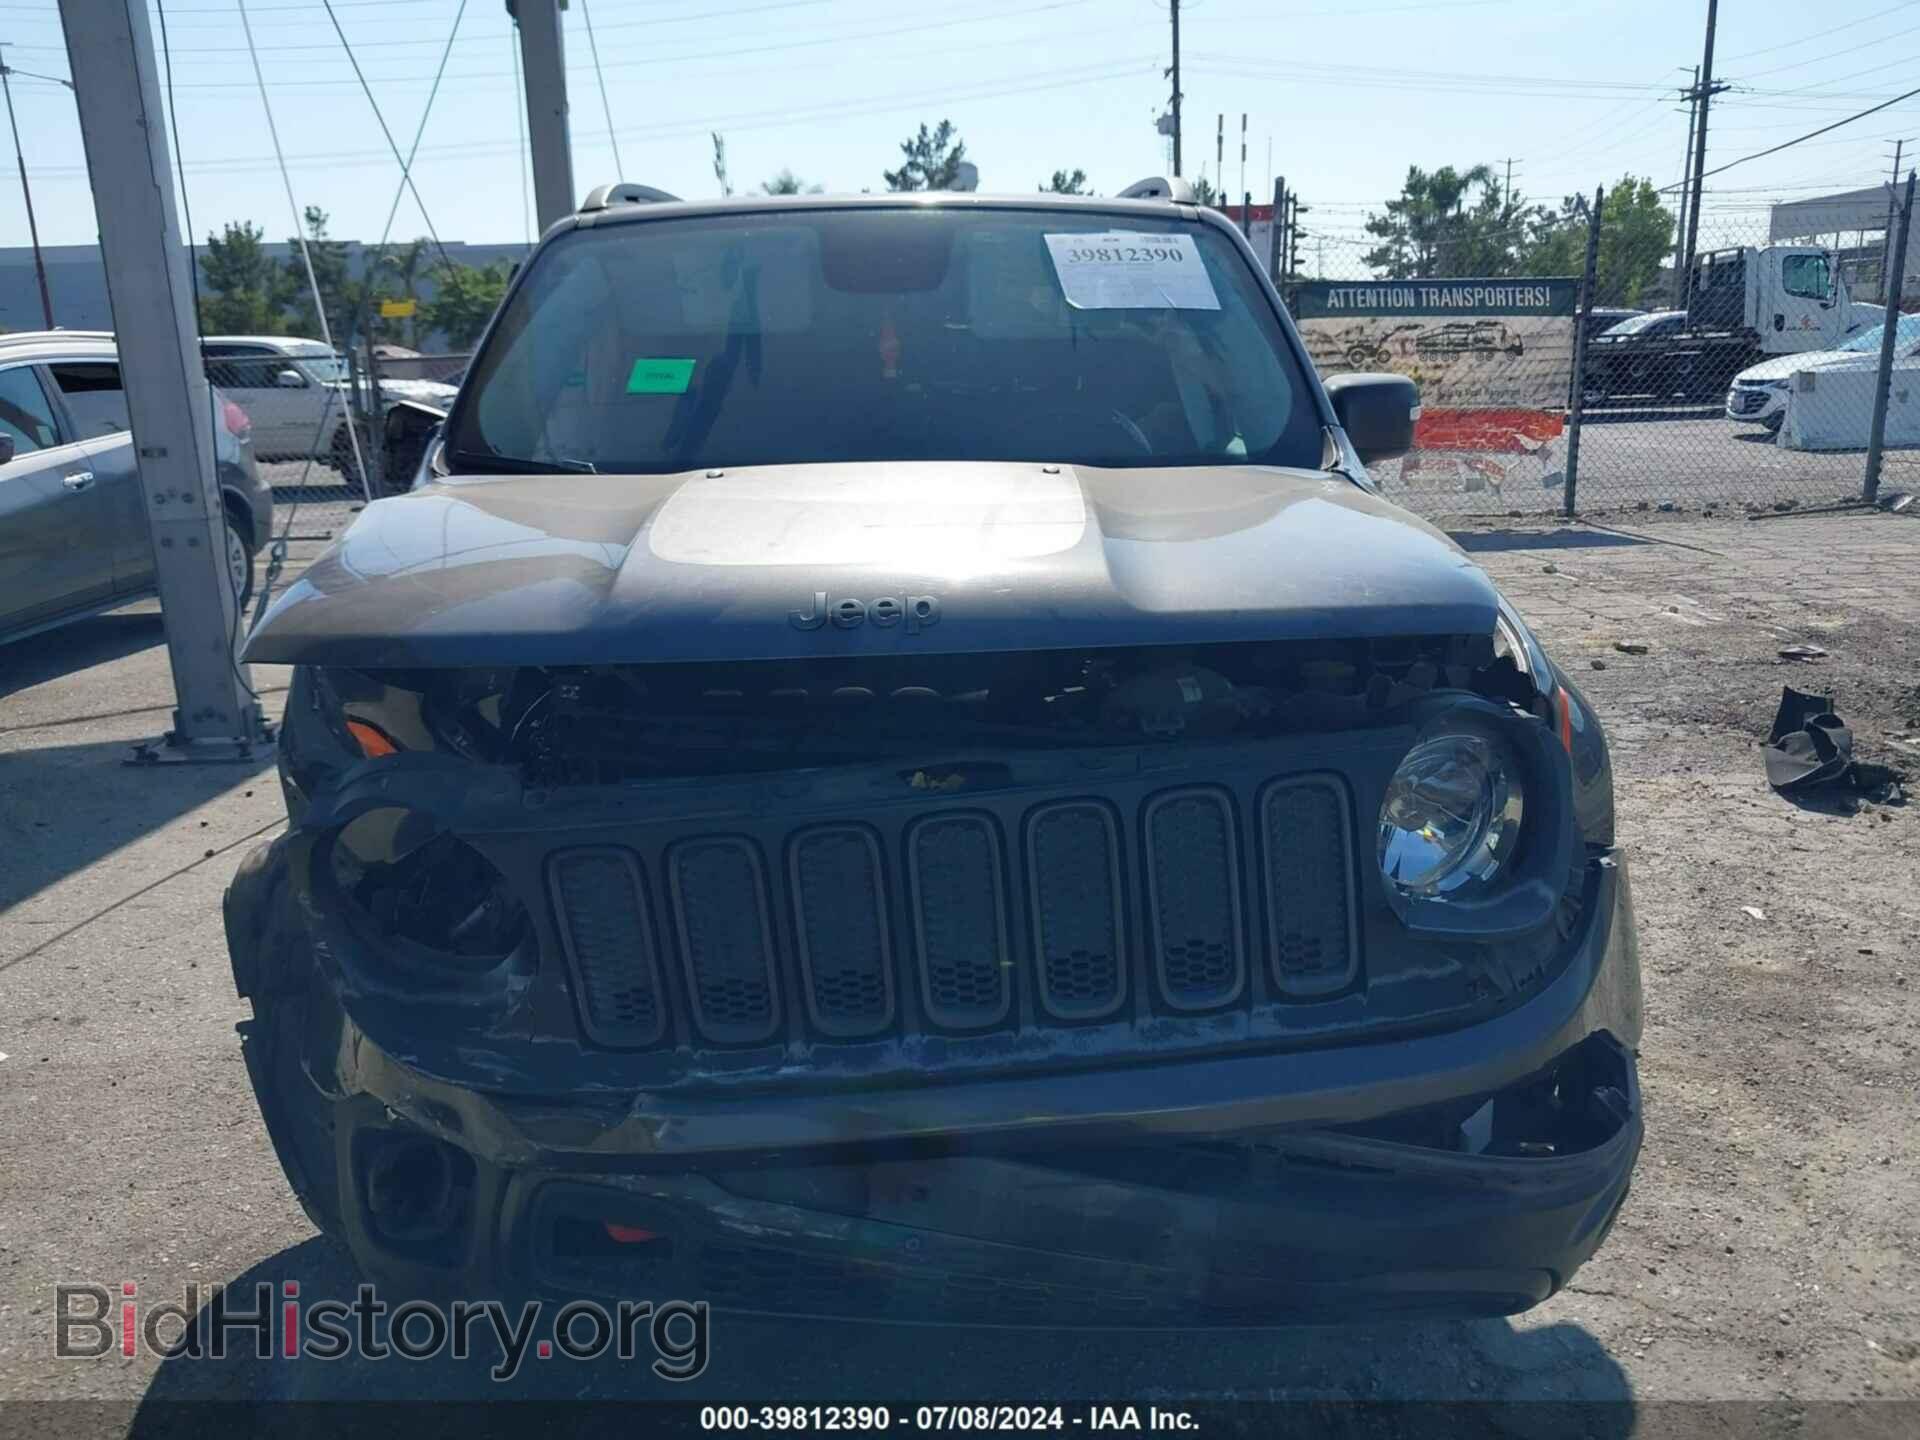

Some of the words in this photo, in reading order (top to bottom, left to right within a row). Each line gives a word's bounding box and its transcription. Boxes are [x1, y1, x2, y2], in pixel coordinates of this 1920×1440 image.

[1068, 248, 1183, 263] 39812390
[1327, 288, 1415, 308] ATTENTION
[1420, 287, 1551, 307] TRANSPORTERS!
[788, 591, 942, 635] Jeep
